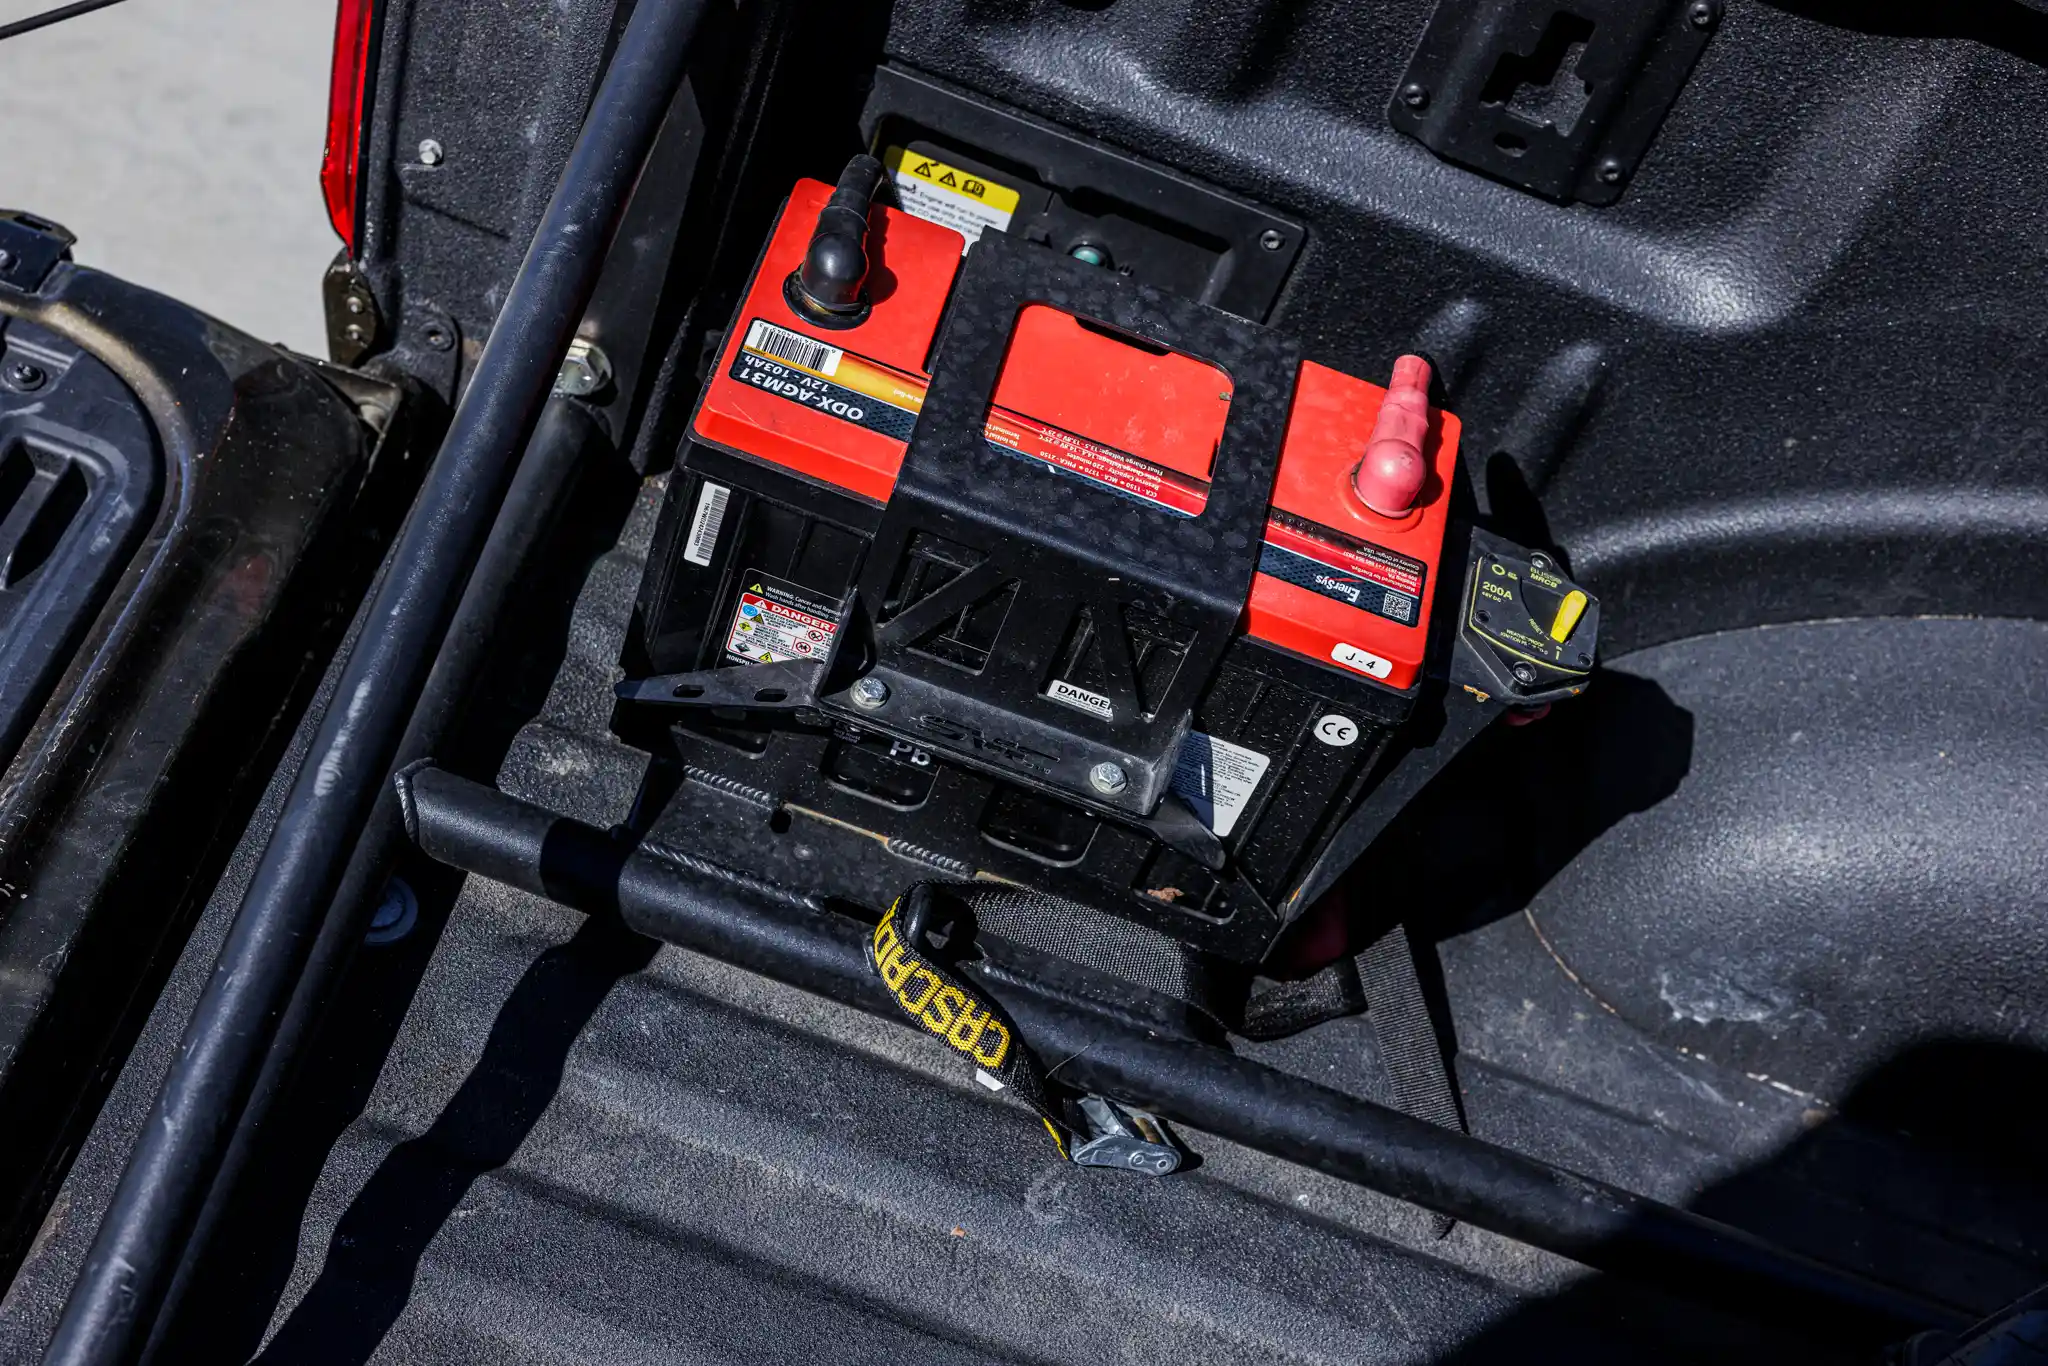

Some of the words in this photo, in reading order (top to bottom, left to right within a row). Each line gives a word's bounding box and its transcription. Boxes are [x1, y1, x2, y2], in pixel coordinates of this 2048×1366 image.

[743, 354, 790, 378] 103Ah
[798, 374, 830, 392] 12V
[738, 367, 864, 421] ODX-AGM31
[1039, 450, 1056, 460] 2150
[1065, 452, 1092, 465] minutes
[1125, 456, 1147, 469] Charge
[1107, 466, 1135, 481] Capacity
[1146, 465, 1163, 475] Float
[1103, 473, 1118, 482] MCA
[1134, 477, 1159, 490] Reserve
[1125, 481, 1140, 490] 1150
[1144, 488, 1157, 496] CCA
[1398, 559, 1419, 570] Country
[1314, 574, 1360, 602] EnerSys
[1380, 576, 1416, 592] Manufactured
[1481, 580, 1515, 600] 200A
[764, 590, 779, 600] Wash
[778, 596, 794, 606] hands
[793, 601, 806, 610] after
[805, 606, 829, 619] handling
[794, 596, 812, 606] Cancer
[1345, 650, 1355, 661] J
[1365, 658, 1375, 669] 4
[1320, 720, 1351, 740] CE
